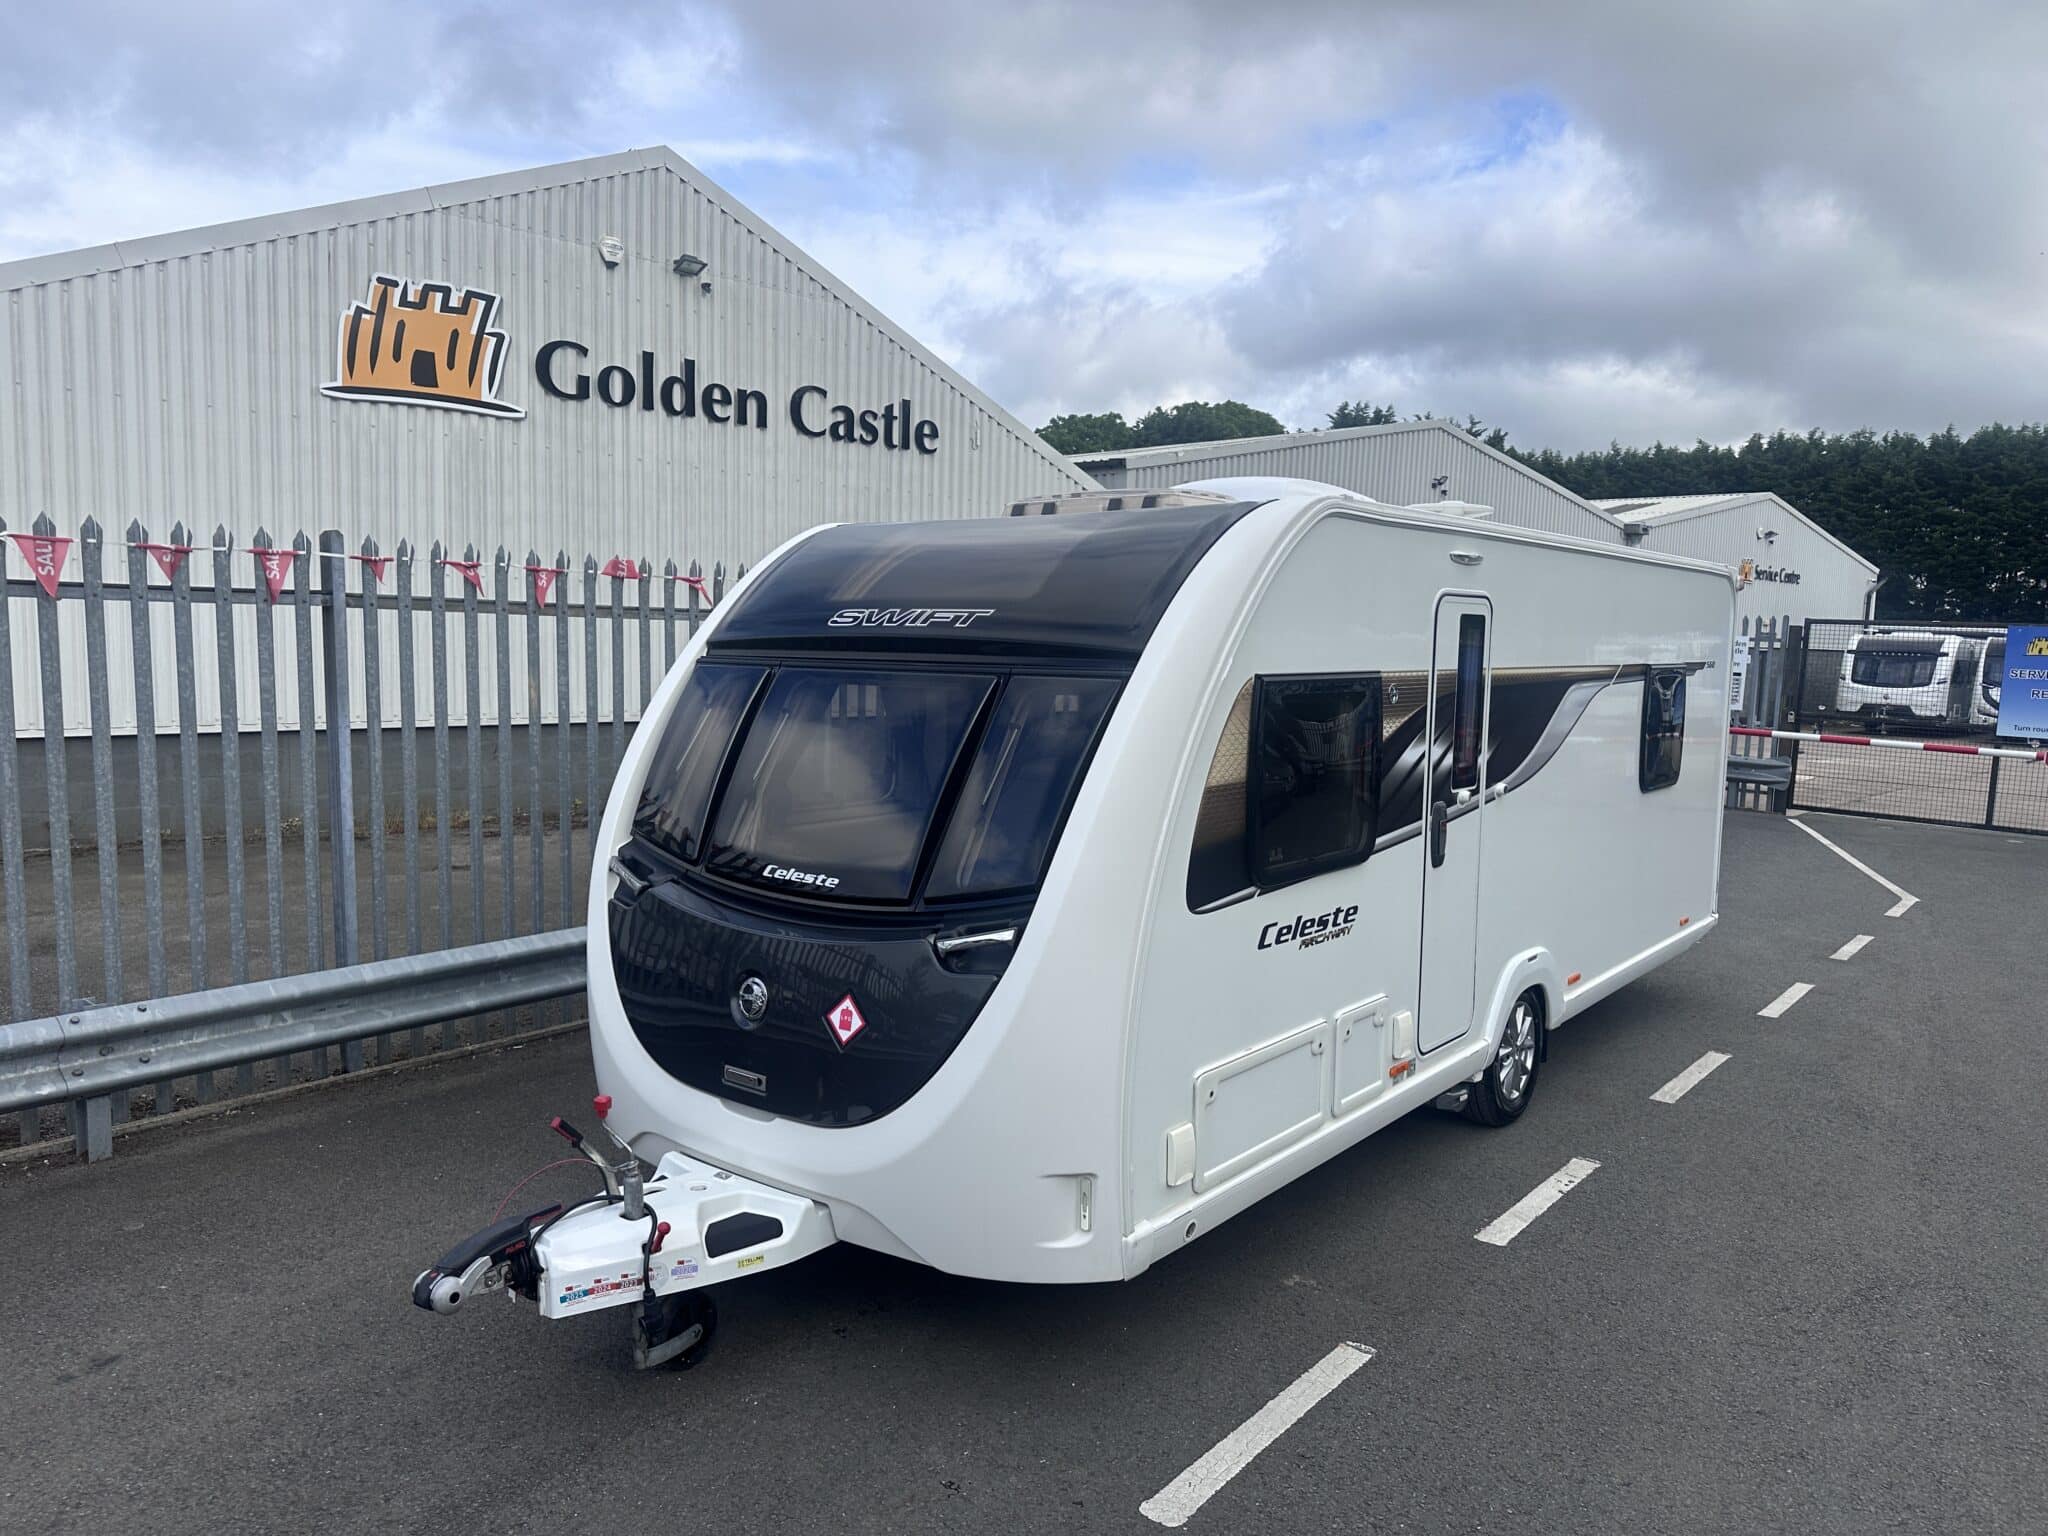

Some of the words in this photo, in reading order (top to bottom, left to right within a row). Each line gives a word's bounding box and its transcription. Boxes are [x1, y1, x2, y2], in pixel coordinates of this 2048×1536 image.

[535, 340, 768, 429] Golden
[790, 385, 939, 454] Castle
[1754, 564, 1778, 582] Service
[1779, 567, 1800, 584] Centre
[827, 608, 996, 627] SWIFT
[2013, 724, 2030, 732] Turn
[762, 864, 840, 888] Celeste
[1257, 905, 1359, 950] Celeste
[1298, 924, 1353, 950] ARCHWAY
[566, 1290, 584, 1301] 2025
[594, 1284, 611, 1294] 2024
